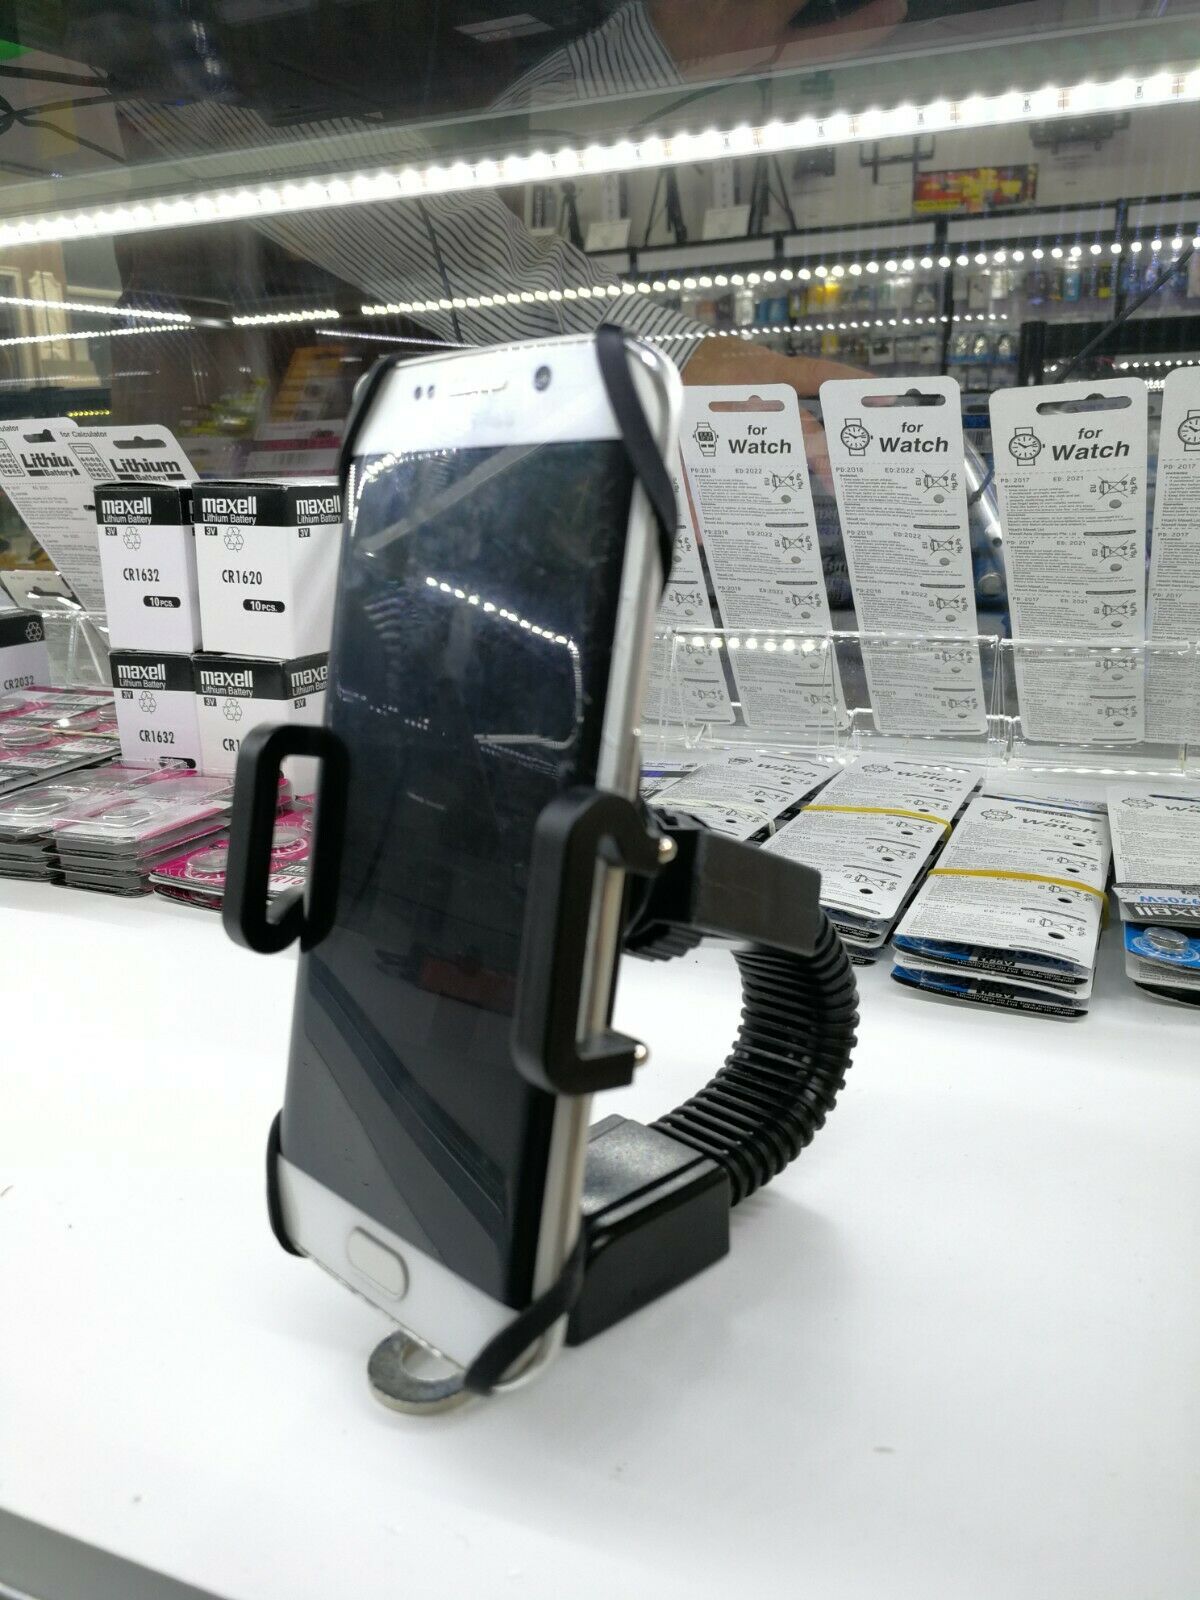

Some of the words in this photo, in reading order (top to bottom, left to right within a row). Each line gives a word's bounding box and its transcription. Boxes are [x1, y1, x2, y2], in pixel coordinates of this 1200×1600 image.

[747, 424, 768, 436] for
[901, 421, 924, 433] for
[1077, 427, 1104, 440] for
[728, 439, 792, 454] Watch
[879, 436, 949, 453] Watch
[1052, 440, 1130, 461] Watch
[109, 458, 182, 473] Lithium
[45, 469, 74, 478] Battery
[102, 497, 152, 515] maxell
[202, 496, 257, 515] maxell
[296, 495, 341, 515] maxell
[103, 514, 127, 524] Lithium
[128, 514, 152, 525] Battery
[203, 513, 228, 523] Lithium
[230, 514, 257, 526] Battery
[296, 515, 320, 525] Lithium
[106, 527, 116, 536] 3V
[206, 527, 217, 536] 3V
[299, 528, 310, 537] 3V
[123, 567, 160, 582] CR1632
[222, 569, 263, 585] CR1620
[118, 663, 166, 681] maxell
[201, 669, 253, 688] maxell
[4, 675, 35, 690] CR2032
[119, 679, 142, 689] Lithium
[143, 679, 166, 690] Battery
[122, 690, 132, 699] 3V
[202, 686, 227, 696] Lithium
[228, 687, 253, 698] Battery
[292, 684, 315, 696] Lithium
[205, 697, 216, 706] 3V
[295, 699, 306, 709] 3V
[139, 729, 175, 744] CR1632
[897, 770, 962, 784] Watch
[1022, 818, 1098, 835] Watch
